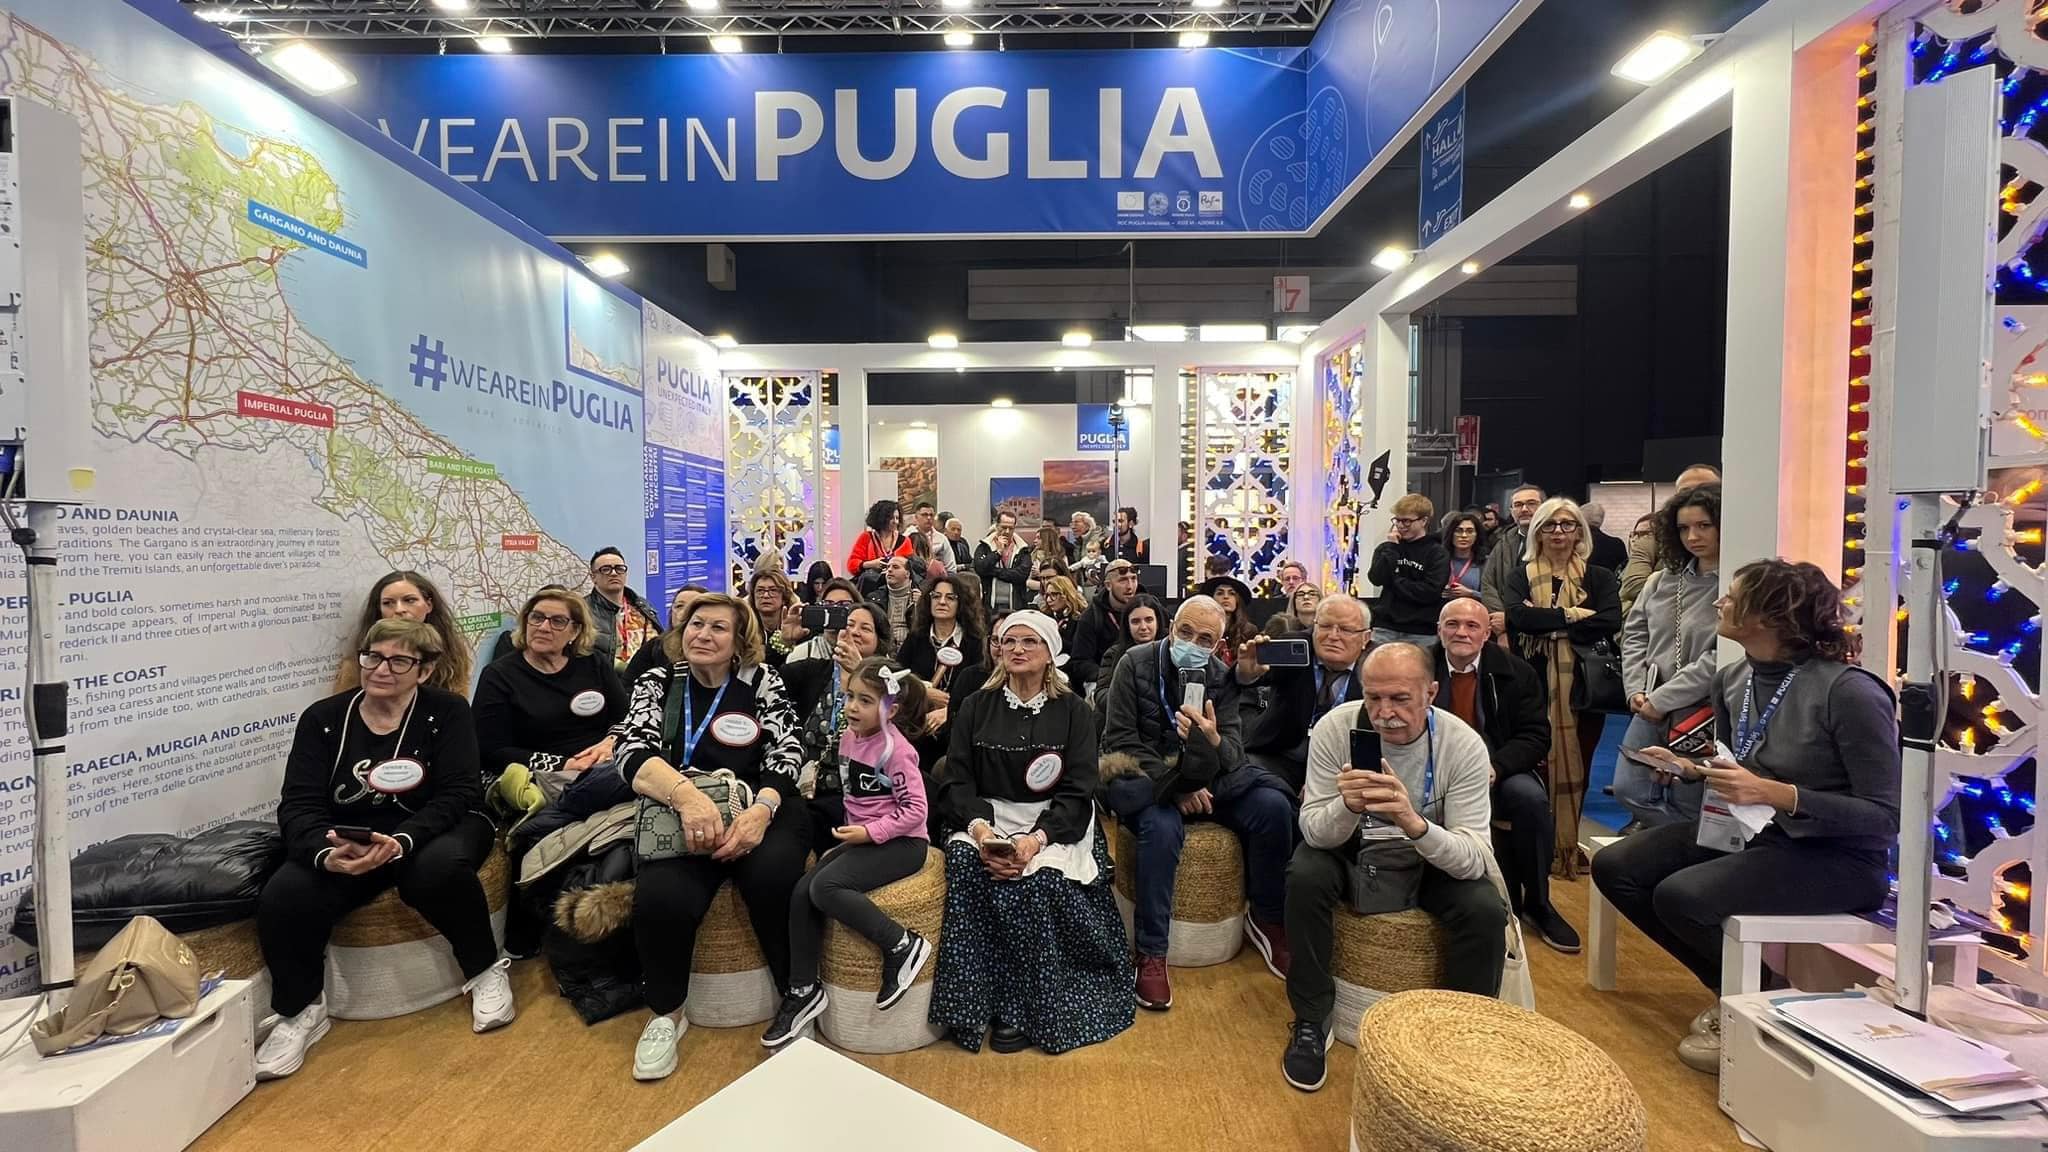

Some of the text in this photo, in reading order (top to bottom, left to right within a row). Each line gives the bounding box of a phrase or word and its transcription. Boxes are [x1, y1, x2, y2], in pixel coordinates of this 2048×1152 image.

[254, 208, 363, 262] GARGANO AND DAUNIA
[409, 334, 634, 433] #WEAREINPUGLIA
[657, 356, 712, 405] PUGLIA
[243, 398, 329, 422] IMPERIAL PUGLIA
[445, 462, 458, 472] AND
[459, 464, 472, 473] THE
[473, 465, 494, 476] COAST
[57, 526, 88, 536] aves,
[92, 524, 133, 538] golden
[136, 525, 178, 535] beaches
[182, 526, 200, 535] and
[203, 526, 258, 537] crystal-clear
[72, 508, 111, 520] AND
[116, 509, 179, 522] DAUNIA
[58, 538, 113, 549] raditions
[119, 538, 140, 548] The
[143, 538, 188, 550] Gargano
[191, 538, 199, 547] is
[201, 539, 214, 548] an
[217, 538, 274, 549] extraordinary
[128, 553, 149, 564] you
[153, 552, 172, 561] can
[176, 550, 204, 562] easily
[207, 550, 234, 560] reach
[237, 550, 251, 559] the
[254, 550, 285, 559] ancient
[80, 567, 100, 577] the
[102, 565, 142, 577] Tremiti
[145, 563, 184, 576] Islands,
[185, 564, 199, 574] an
[201, 561, 262, 574] unforgettable
[64, 608, 89, 621] and
[92, 605, 118, 618] bold
[159, 600, 215, 613] sometimes
[216, 598, 242, 608] harsh
[244, 597, 260, 606] and
[69, 590, 134, 606] PUGLIA
[59, 636, 108, 650] rederick
[121, 632, 142, 643] and
[145, 629, 173, 641] three
[175, 625, 200, 637] cities
[213, 622, 228, 633] art
[229, 619, 249, 631] with
[258, 616, 291, 630] glorious
[65, 619, 126, 635] landscape
[198, 610, 236, 623] Imperial
[273, 603, 315, 615] dominated
[59, 653, 88, 665] rani.
[73, 665, 168, 691] THE COAST
[86, 688, 126, 706] fishing
[128, 683, 158, 697] ports
[159, 678, 179, 690] and
[181, 672, 217, 687] villages
[218, 666, 254, 682] perched
[70, 708, 94, 720] and
[97, 705, 116, 715] sea
[119, 700, 153, 712] caress
[156, 689, 195, 704] ancient
[196, 684, 223, 696] stone
[225, 680, 248, 692] walls
[250, 676, 266, 687] and
[268, 672, 291, 683] tower
[80, 717, 109, 734] from
[114, 712, 134, 726] the
[137, 706, 169, 721] inside
[172, 701, 193, 714] too,
[196, 695, 219, 709] with
[273, 681, 299, 694] castles
[302, 678, 316, 688] and
[146, 733, 208, 759] MURGIA
[211, 726, 240, 743] AND
[243, 712, 297, 735] GRAVINE
[92, 768, 134, 786] reverse
[202, 743, 236, 757] natural
[155, 767, 184, 783] stone
[195, 759, 212, 772] the
[214, 749, 251, 766] absolute
[94, 801, 108, 814] of
[110, 796, 129, 809] the
[131, 789, 160, 804] Terra
[162, 779, 187, 794] delle
[188, 767, 225, 785] Gravine
[227, 762, 243, 774] and
[245, 755, 277, 770] ancient
